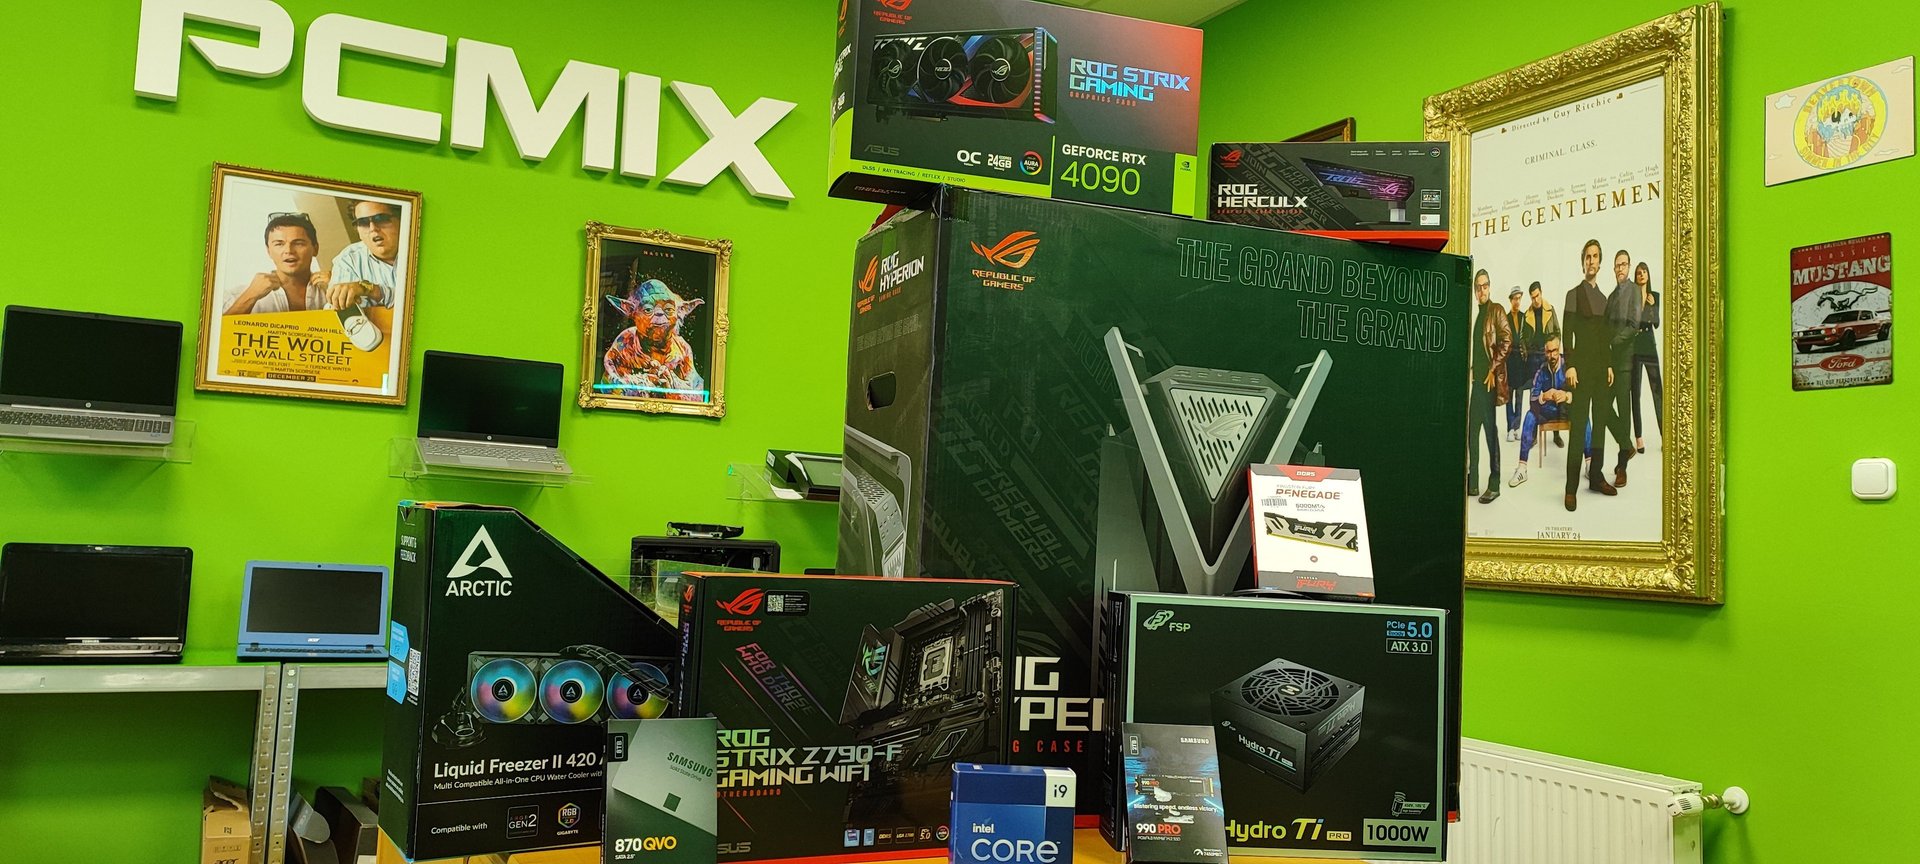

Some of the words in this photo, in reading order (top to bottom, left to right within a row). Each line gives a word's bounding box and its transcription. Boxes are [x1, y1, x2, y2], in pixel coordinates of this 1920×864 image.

[1070, 58, 1118, 80] ROG
[1123, 66, 1190, 92] STRIX
[1070, 74, 1154, 102] GAMING
[134, 0, 798, 201] PCMIX
[1511, 118, 1540, 132] Directed
[1553, 108, 1571, 120] Guy
[1575, 96, 1612, 112] Ritchie
[864, 144, 900, 156] ASUS
[1570, 139, 1598, 153] CLASS.
[957, 150, 982, 165] OC
[1062, 144, 1120, 162] GEFORCE
[1122, 152, 1146, 166] RTX
[1060, 161, 1141, 196] 4090
[1218, 184, 1258, 196] ROG
[1218, 196, 1308, 208] HERCULX
[1472, 214, 1510, 238] THE
[1522, 180, 1662, 228] GENTLEMEN
[881, 251, 900, 275] ROG
[1792, 254, 1891, 286] MUSTANG
[880, 256, 924, 293] HYPERION
[972, 269, 1020, 283] REPUBLIC
[1022, 275, 1036, 284] OF
[1176, 237, 1232, 283] THE
[1238, 246, 1334, 295] GRAND
[1340, 259, 1448, 309] BEYOND
[982, 279, 1024, 290] GAMERS
[234, 320, 268, 328] LEONARDO
[1296, 300, 1349, 343] THE
[1355, 307, 1447, 354] GRAND
[233, 332, 280, 350] THE
[288, 337, 353, 356] WOLF
[232, 348, 250, 357] OF
[254, 348, 295, 361] WALL
[300, 353, 352, 366] STREET
[1828, 357, 1856, 369] Ford
[1276, 488, 1341, 500] RENEGADE
[1537, 531, 1572, 540] JANUARY
[446, 580, 512, 596] ARCTIC
[1170, 622, 1191, 632] FSP
[1386, 620, 1406, 630] PCIe
[1407, 621, 1432, 638] 5.0
[1390, 641, 1410, 652] ATX
[1412, 642, 1428, 652] 3.0
[736, 646, 766, 674] WHO
[762, 676, 800, 712] DARE
[746, 642, 776, 671] FOR
[775, 672, 814, 715] THOSE
[717, 728, 772, 748] ROG
[1037, 740, 1084, 752] CASE
[1238, 734, 1266, 757] Hydro
[1267, 747, 1281, 760] Ti
[717, 748, 796, 768] STRIX
[802, 744, 904, 765] Z790-F
[434, 760, 484, 780] Liquid
[490, 757, 548, 774] Freezer
[552, 754, 562, 769] II
[566, 752, 596, 768] 420
[667, 752, 714, 778] SAMSUNG
[434, 782, 452, 790] Multi
[454, 778, 493, 790] Compatible
[494, 776, 529, 786] All-in-One
[531, 774, 546, 782] CPU
[547, 772, 568, 781] Water
[568, 771, 590, 780] Cooler
[717, 766, 814, 788] GAMING
[820, 764, 870, 784] WIFI
[717, 788, 782, 798] OTHERBOARD
[1053, 784, 1068, 798] i9
[562, 808, 577, 816] RGB
[431, 824, 471, 835] Compatible
[472, 822, 488, 831] with
[920, 832, 931, 840] 5.0
[972, 822, 994, 834] intel
[1136, 823, 1156, 834] 990
[1158, 824, 1181, 834] PRO
[1225, 820, 1287, 842] Hydro
[1292, 818, 1324, 840] Ti
[1329, 832, 1350, 840] PRO
[1367, 824, 1430, 842] 1000W
[615, 838, 642, 852] 870
[644, 836, 676, 851] QVO
[717, 842, 752, 854] SUS
